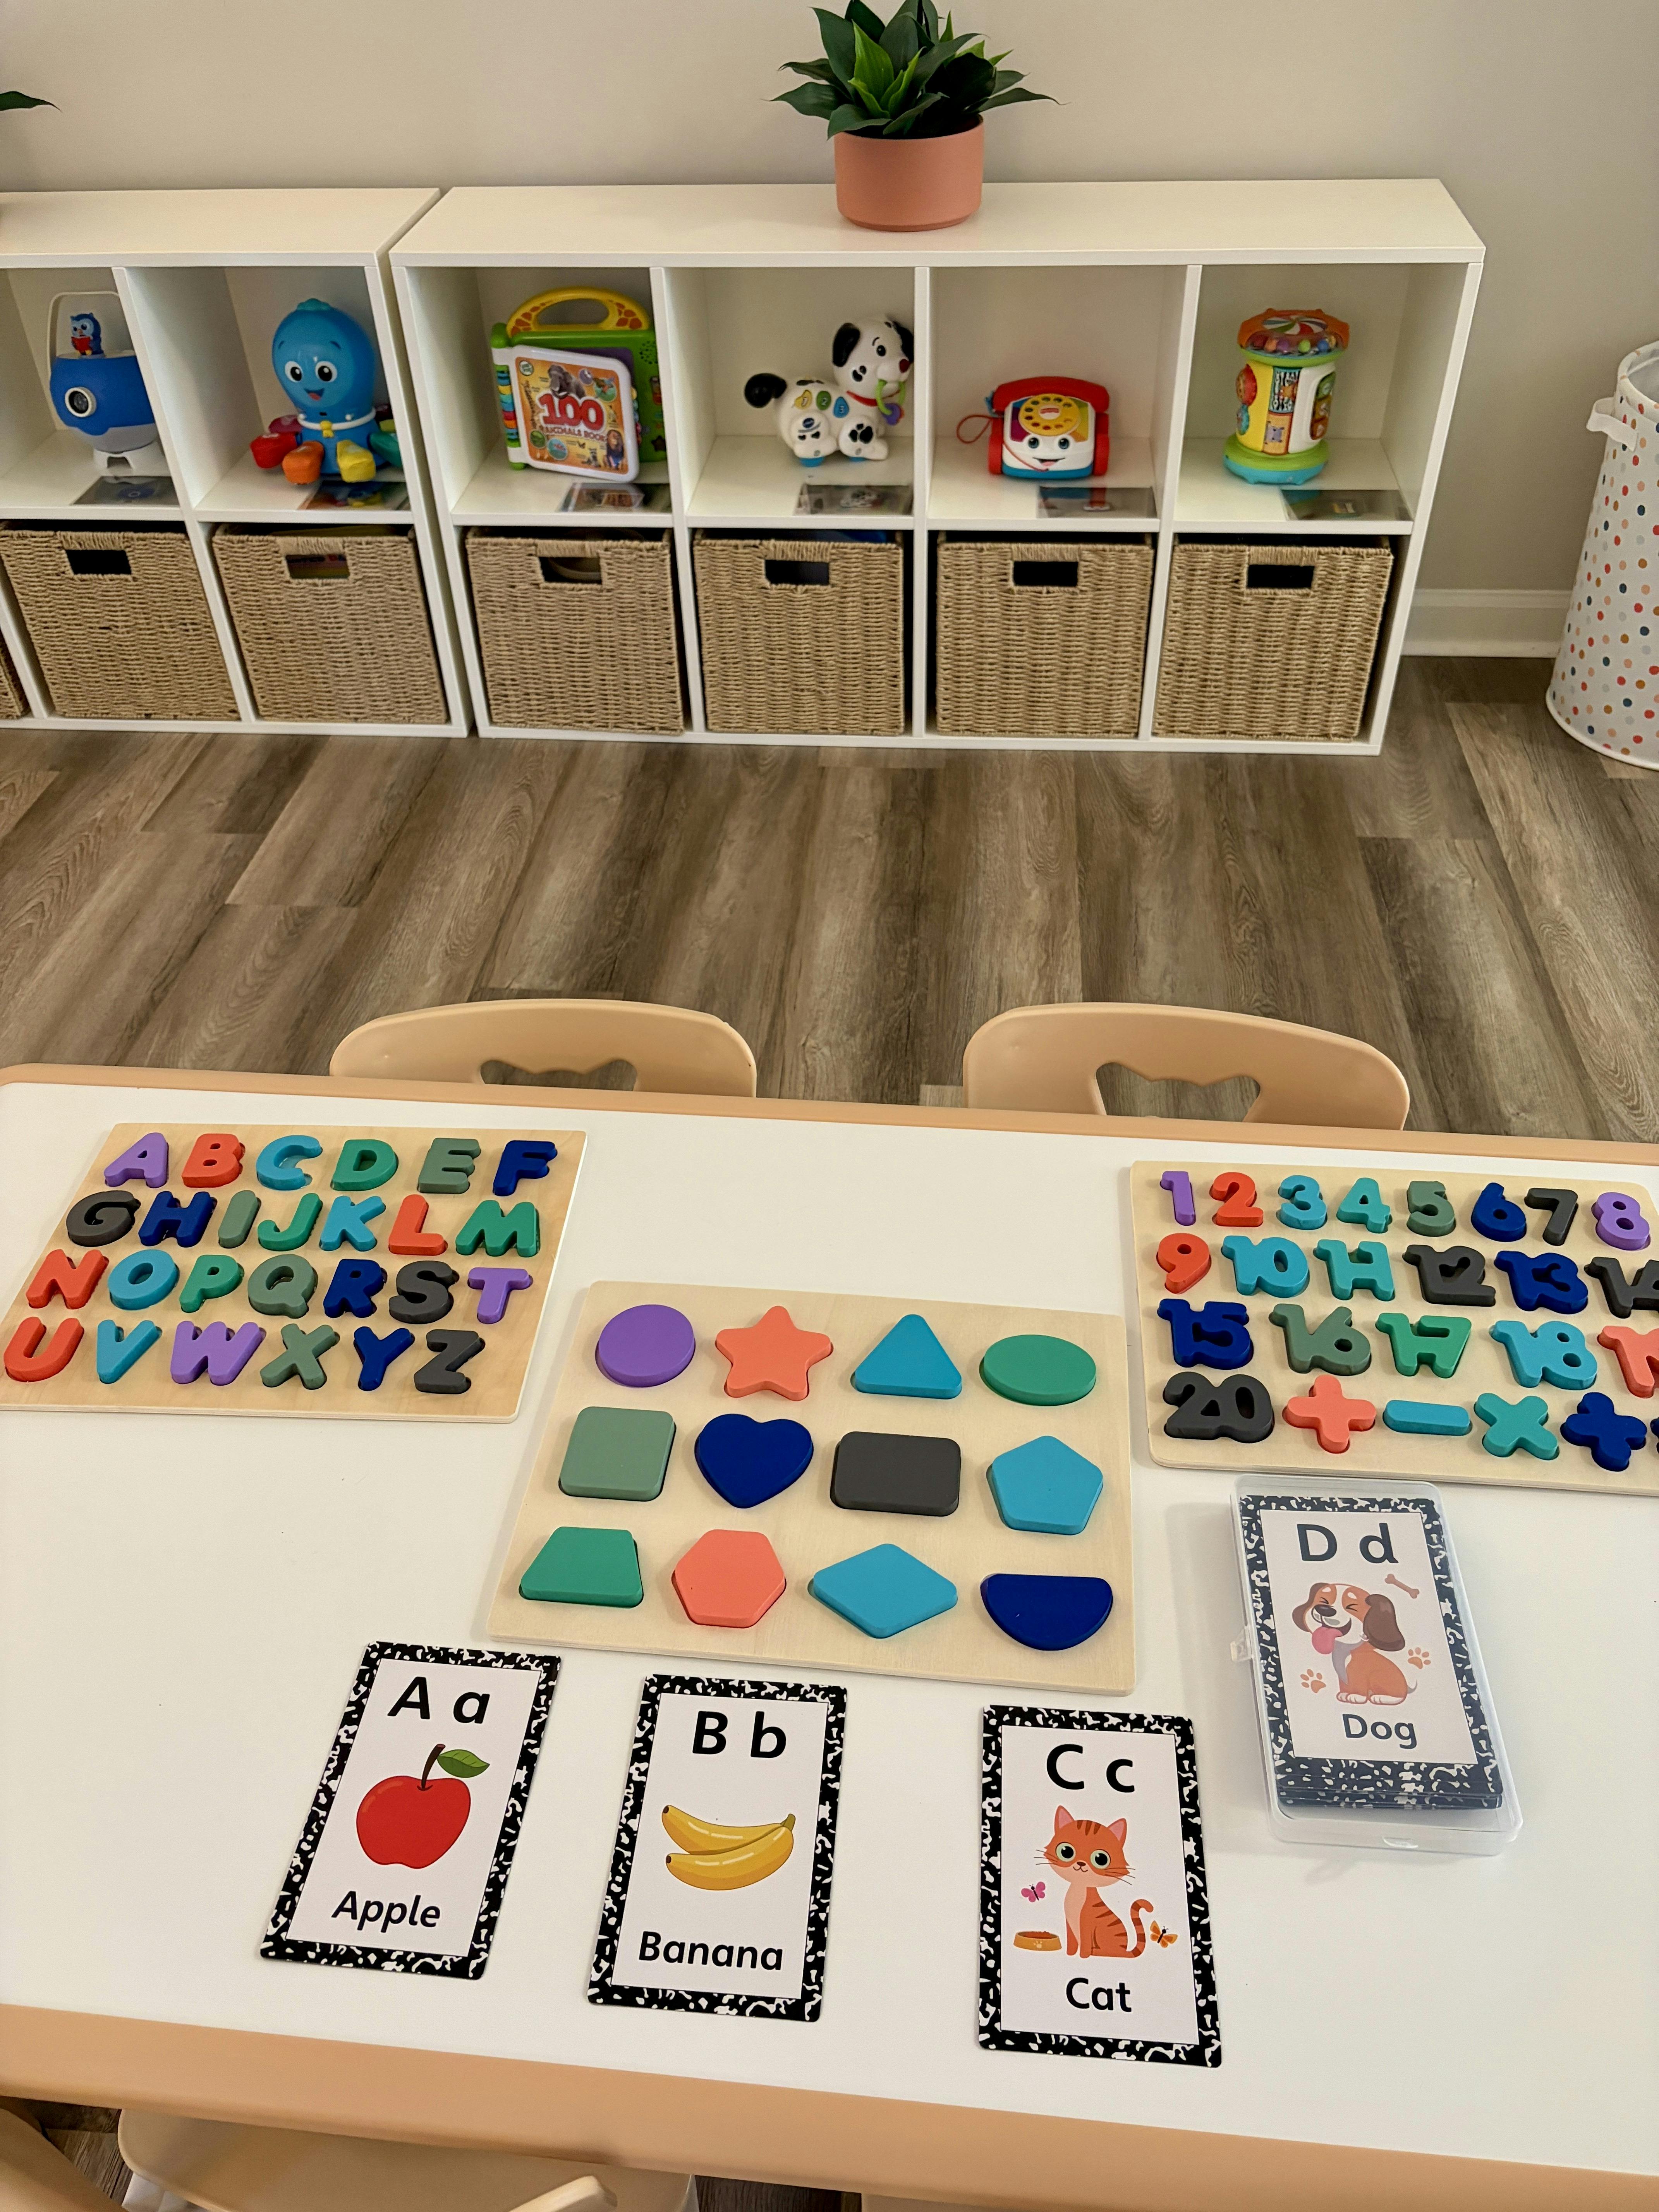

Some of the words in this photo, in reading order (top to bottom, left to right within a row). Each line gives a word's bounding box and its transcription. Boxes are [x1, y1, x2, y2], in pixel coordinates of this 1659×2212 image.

[538, 393, 604, 431] 100
[821, 397, 828, 406] 2
[104, 1132, 168, 1188] A
[182, 1133, 244, 1188] B
[256, 1135, 323, 1190] C
[331, 1139, 398, 1191] D
[418, 1138, 481, 1194] E
[493, 1140, 557, 1196] F
[66, 1190, 140, 1247] G
[138, 1191, 216, 1247] H
[218, 1190, 260, 1249] I
[258, 1193, 323, 1251] J
[320, 1196, 386, 1251] K
[389, 1194, 447, 1255] L
[456, 1200, 540, 1257] M
[1160, 1171, 1196, 1226] 1
[1211, 1172, 1263, 1227] 2
[1278, 1175, 1327, 1230] 3
[1336, 1178, 1391, 1233] 4
[1407, 1181, 1455, 1237] 5
[1471, 1182, 1526, 1241] 6
[1524, 1188, 1578, 1246] 7
[1592, 1192, 1650, 1250] 8
[26, 1249, 108, 1309] N
[108, 1249, 179, 1310] O
[179, 1255, 243, 1313] P
[248, 1254, 318, 1318] Q
[324, 1259, 386, 1317] R
[389, 1260, 458, 1324] S
[468, 1267, 532, 1324] T
[1156, 1233, 1211, 1294] 9
[1221, 1235, 1310, 1298] 10
[1402, 1244, 1496, 1307] 12
[1494, 1250, 1588, 1314] 13
[3, 1317, 84, 1382] U
[97, 1319, 161, 1383] V
[170, 1321, 265, 1386] W
[260, 1323, 339, 1389] X
[354, 1326, 415, 1391] Y
[414, 1329, 484, 1394] Z
[1158, 1298, 1254, 1370] 15
[1269, 1304, 1371, 1376] 16
[1376, 1313, 1471, 1378] 17
[1489, 1321, 1597, 1390] 18
[1163, 1372, 1274, 1443] 20
[1297, 1523, 1338, 1562] D
[1359, 1523, 1399, 1564] d
[388, 1676, 431, 1720] A
[453, 1692, 490, 1724] a
[692, 1711, 728, 1755] B
[750, 1711, 787, 1758] b
[1342, 1714, 1417, 1749] Dog
[1046, 1744, 1085, 1790] C
[1106, 1759, 1135, 1793] c
[331, 1891, 441, 1933] Apple
[639, 1931, 783, 1971] Banana
[1066, 1977, 1132, 2013] Cat
